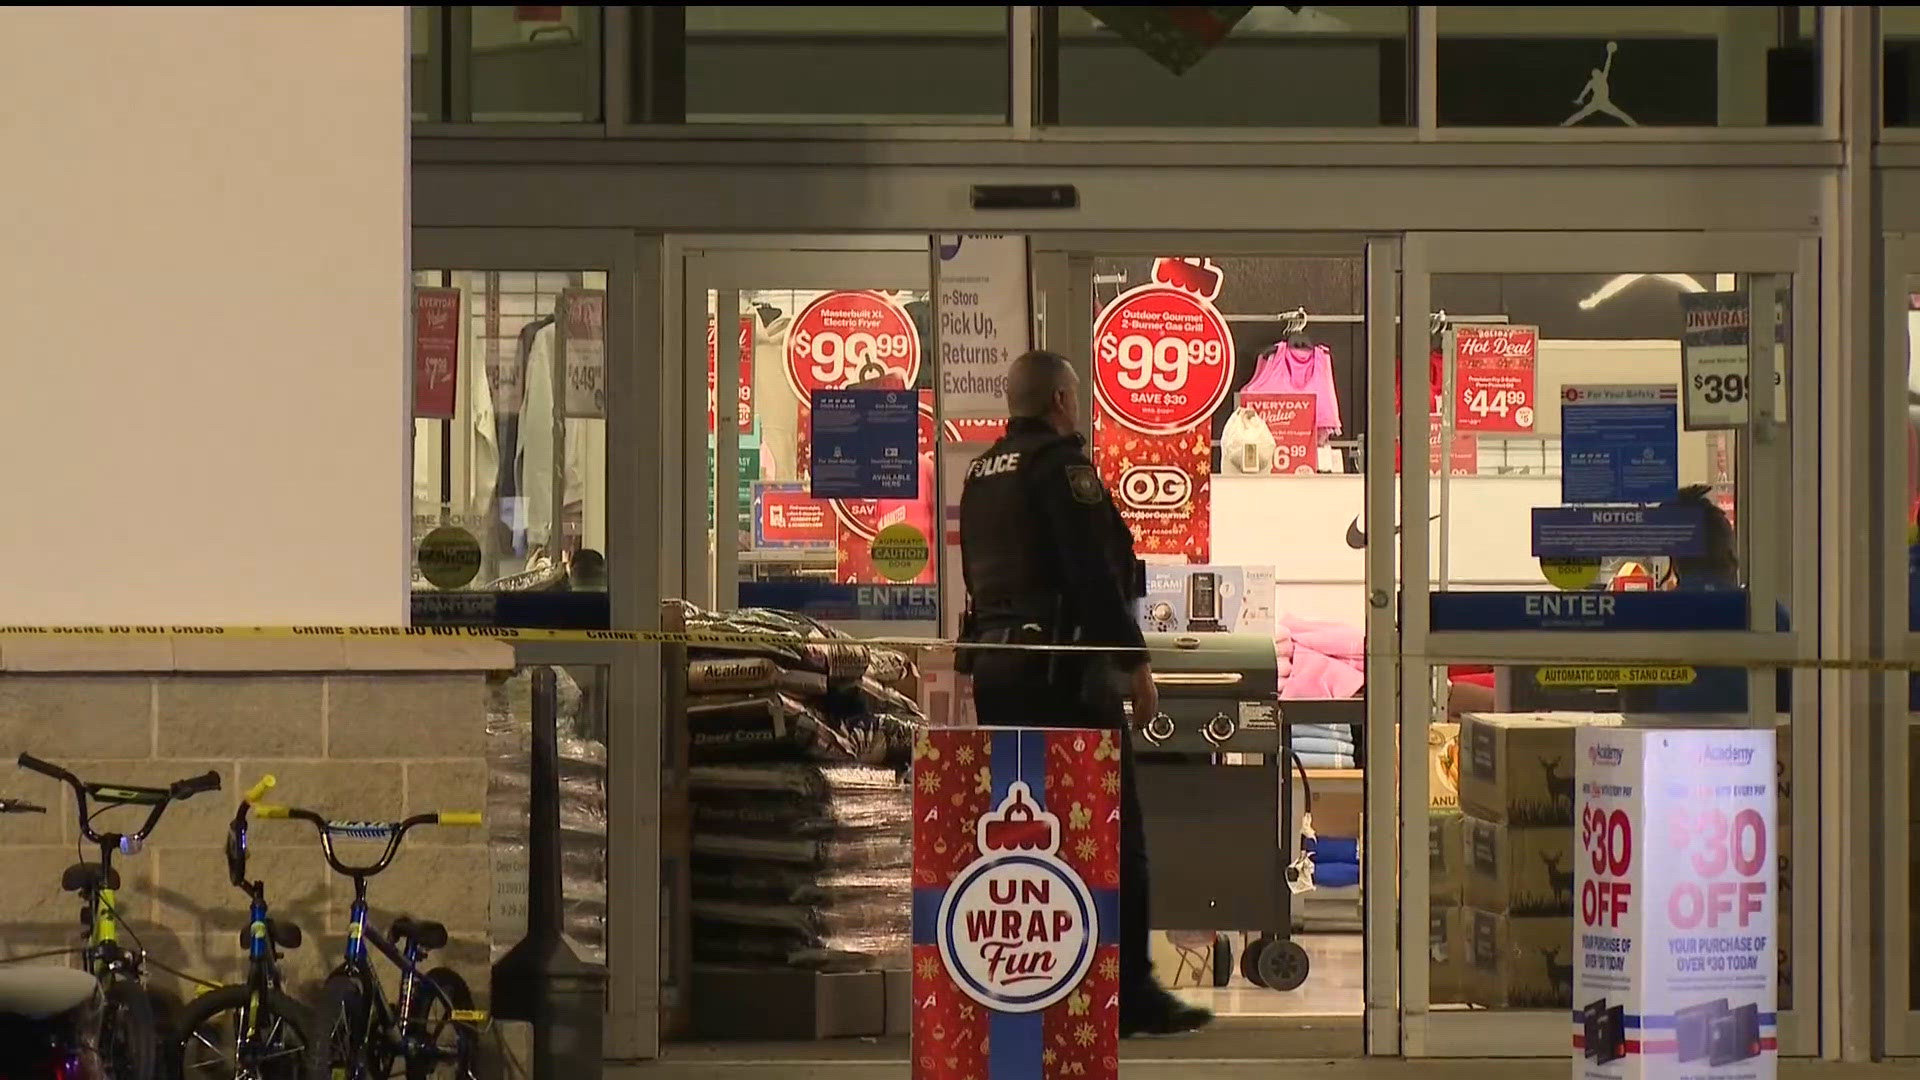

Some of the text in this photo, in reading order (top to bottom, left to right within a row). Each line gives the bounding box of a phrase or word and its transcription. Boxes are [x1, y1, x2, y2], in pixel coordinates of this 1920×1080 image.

[820, 309, 884, 319] Masterbuilt XL
[1122, 309, 1203, 323] Outdoor Gourmet
[823, 318, 881, 329] Electric Fryer
[941, 312, 997, 339] Pick Up,
[1121, 319, 1204, 333] 2-Burner Gas Grill
[1480, 330, 1514, 339] HOLIDAY
[942, 341, 1009, 365] Returns +
[1460, 337, 1532, 356] Hot Deal
[1131, 392, 1188, 405] SAVE $30
[1587, 388, 1655, 400] For Your Safety
[1246, 401, 1310, 410] EVERYDAY
[1259, 409, 1297, 423] Value
[966, 452, 1021, 480] POLICE
[1126, 472, 1186, 503] OG
[852, 505, 877, 515] SAV
[1592, 511, 1644, 523] NOTICE
[875, 549, 925, 559] CAUTION
[857, 586, 936, 606] ENTER
[1525, 595, 1616, 616] ENTER
[704, 663, 769, 680] Academy
[1545, 668, 1595, 682] AUTOMATIC
[1596, 669, 1620, 682] DOOR
[1629, 668, 1656, 681] STAND
[1659, 668, 1688, 681] CLEAR
[735, 729, 772, 741] Corn
[1582, 801, 1632, 877] $30
[1667, 806, 1767, 878] $30
[988, 879, 1050, 905] UN
[1582, 878, 1632, 929] OFF
[1667, 881, 1767, 930] OFF
[966, 909, 1073, 943] WRAP
[1668, 936, 1767, 954] YOUR PURCHASE OF
[979, 940, 1058, 982] Fun
[1677, 955, 1759, 972] OVER $30 TODAY
